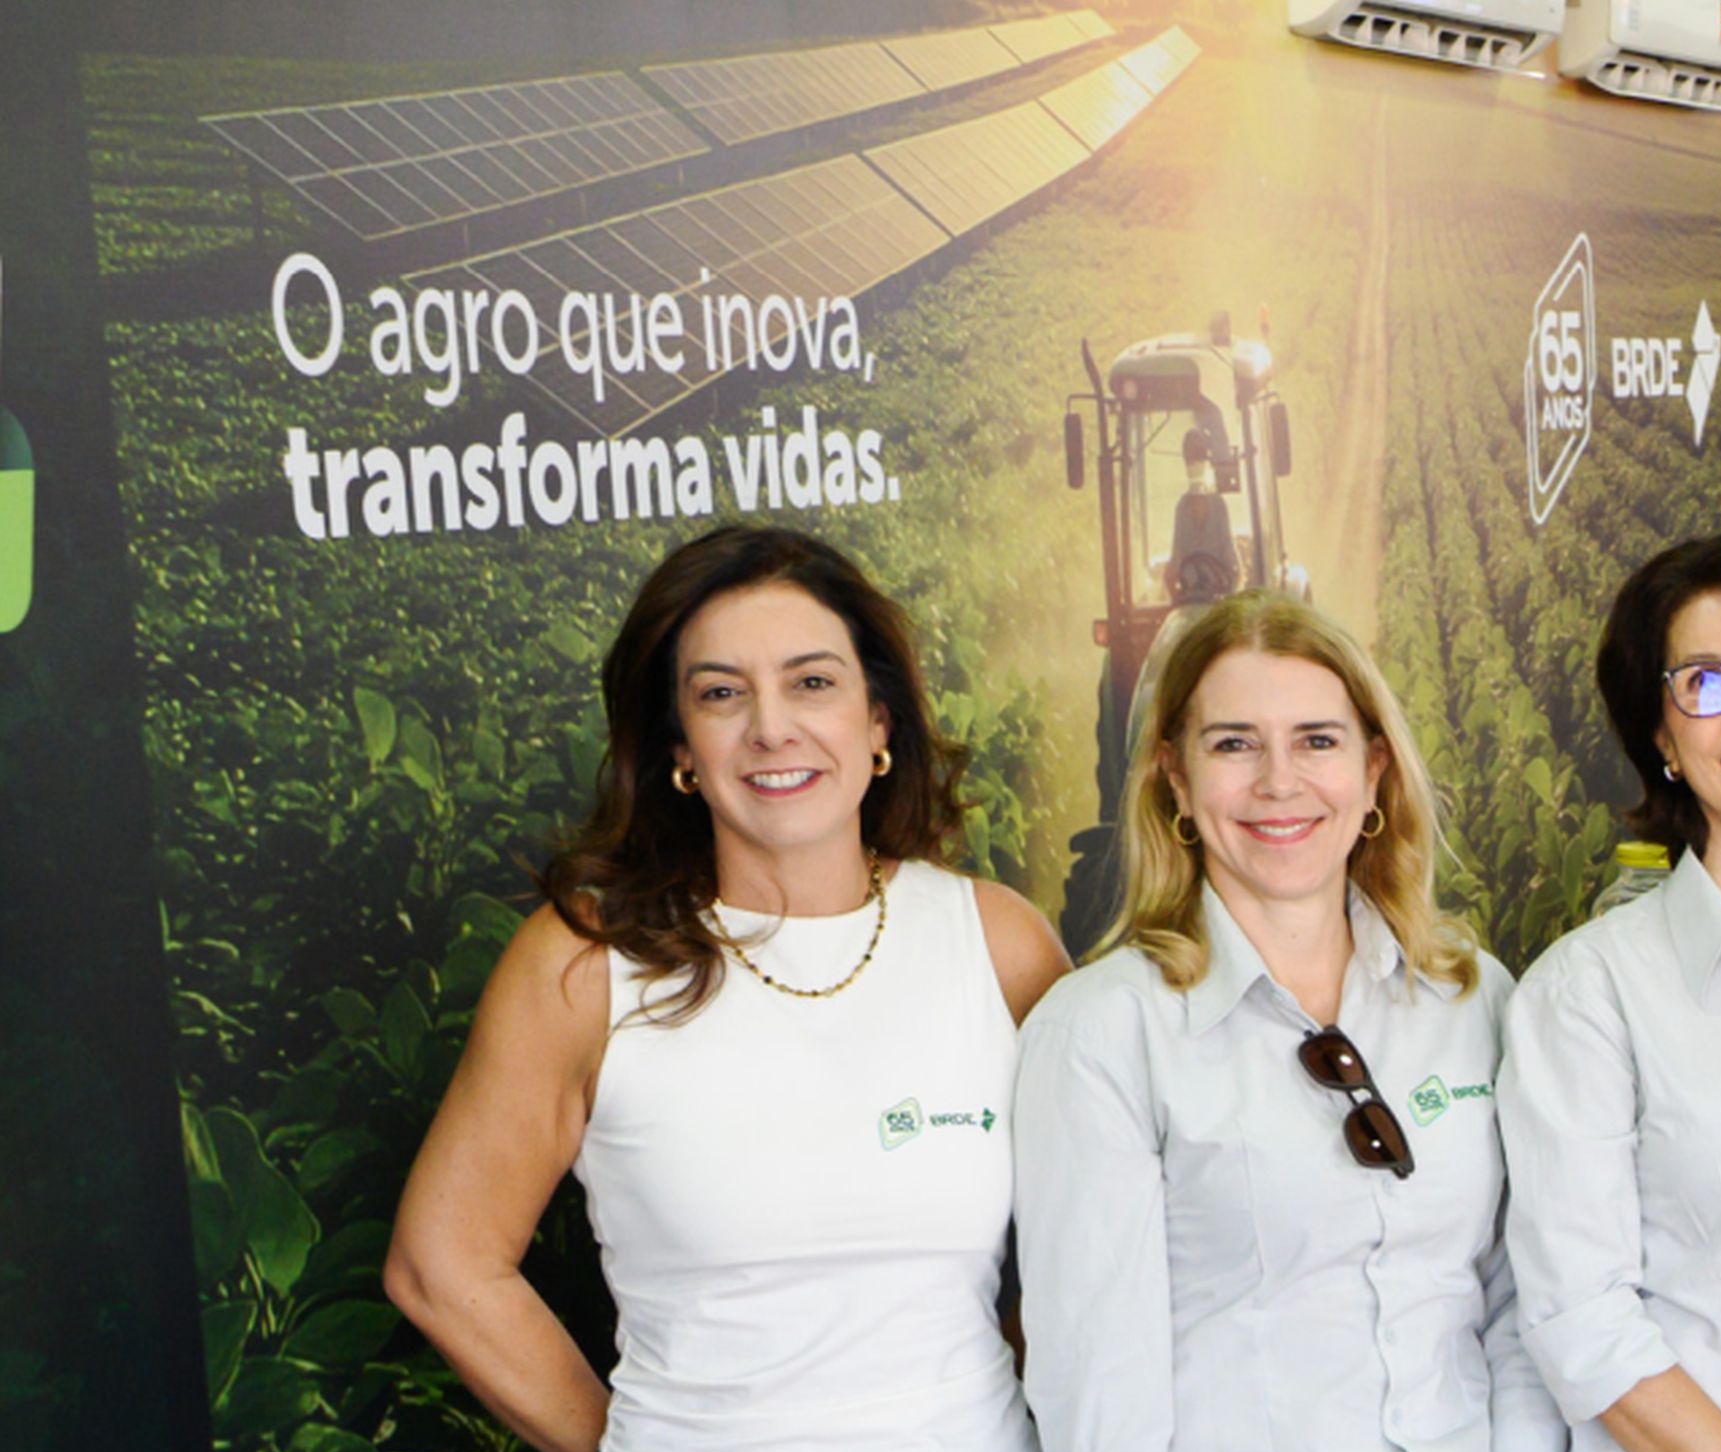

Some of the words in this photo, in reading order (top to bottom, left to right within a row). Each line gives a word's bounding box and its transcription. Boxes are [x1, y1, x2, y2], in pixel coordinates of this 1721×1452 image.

[272, 252, 344, 376] O
[370, 286, 539, 407] agro
[559, 290, 685, 403] que
[700, 267, 876, 382] inova,
[1540, 310, 1584, 393] 65
[1611, 337, 1685, 398] BRDE
[1542, 396, 1586, 431] ANOS
[284, 411, 715, 540] transforma
[723, 404, 900, 512] vidas.
